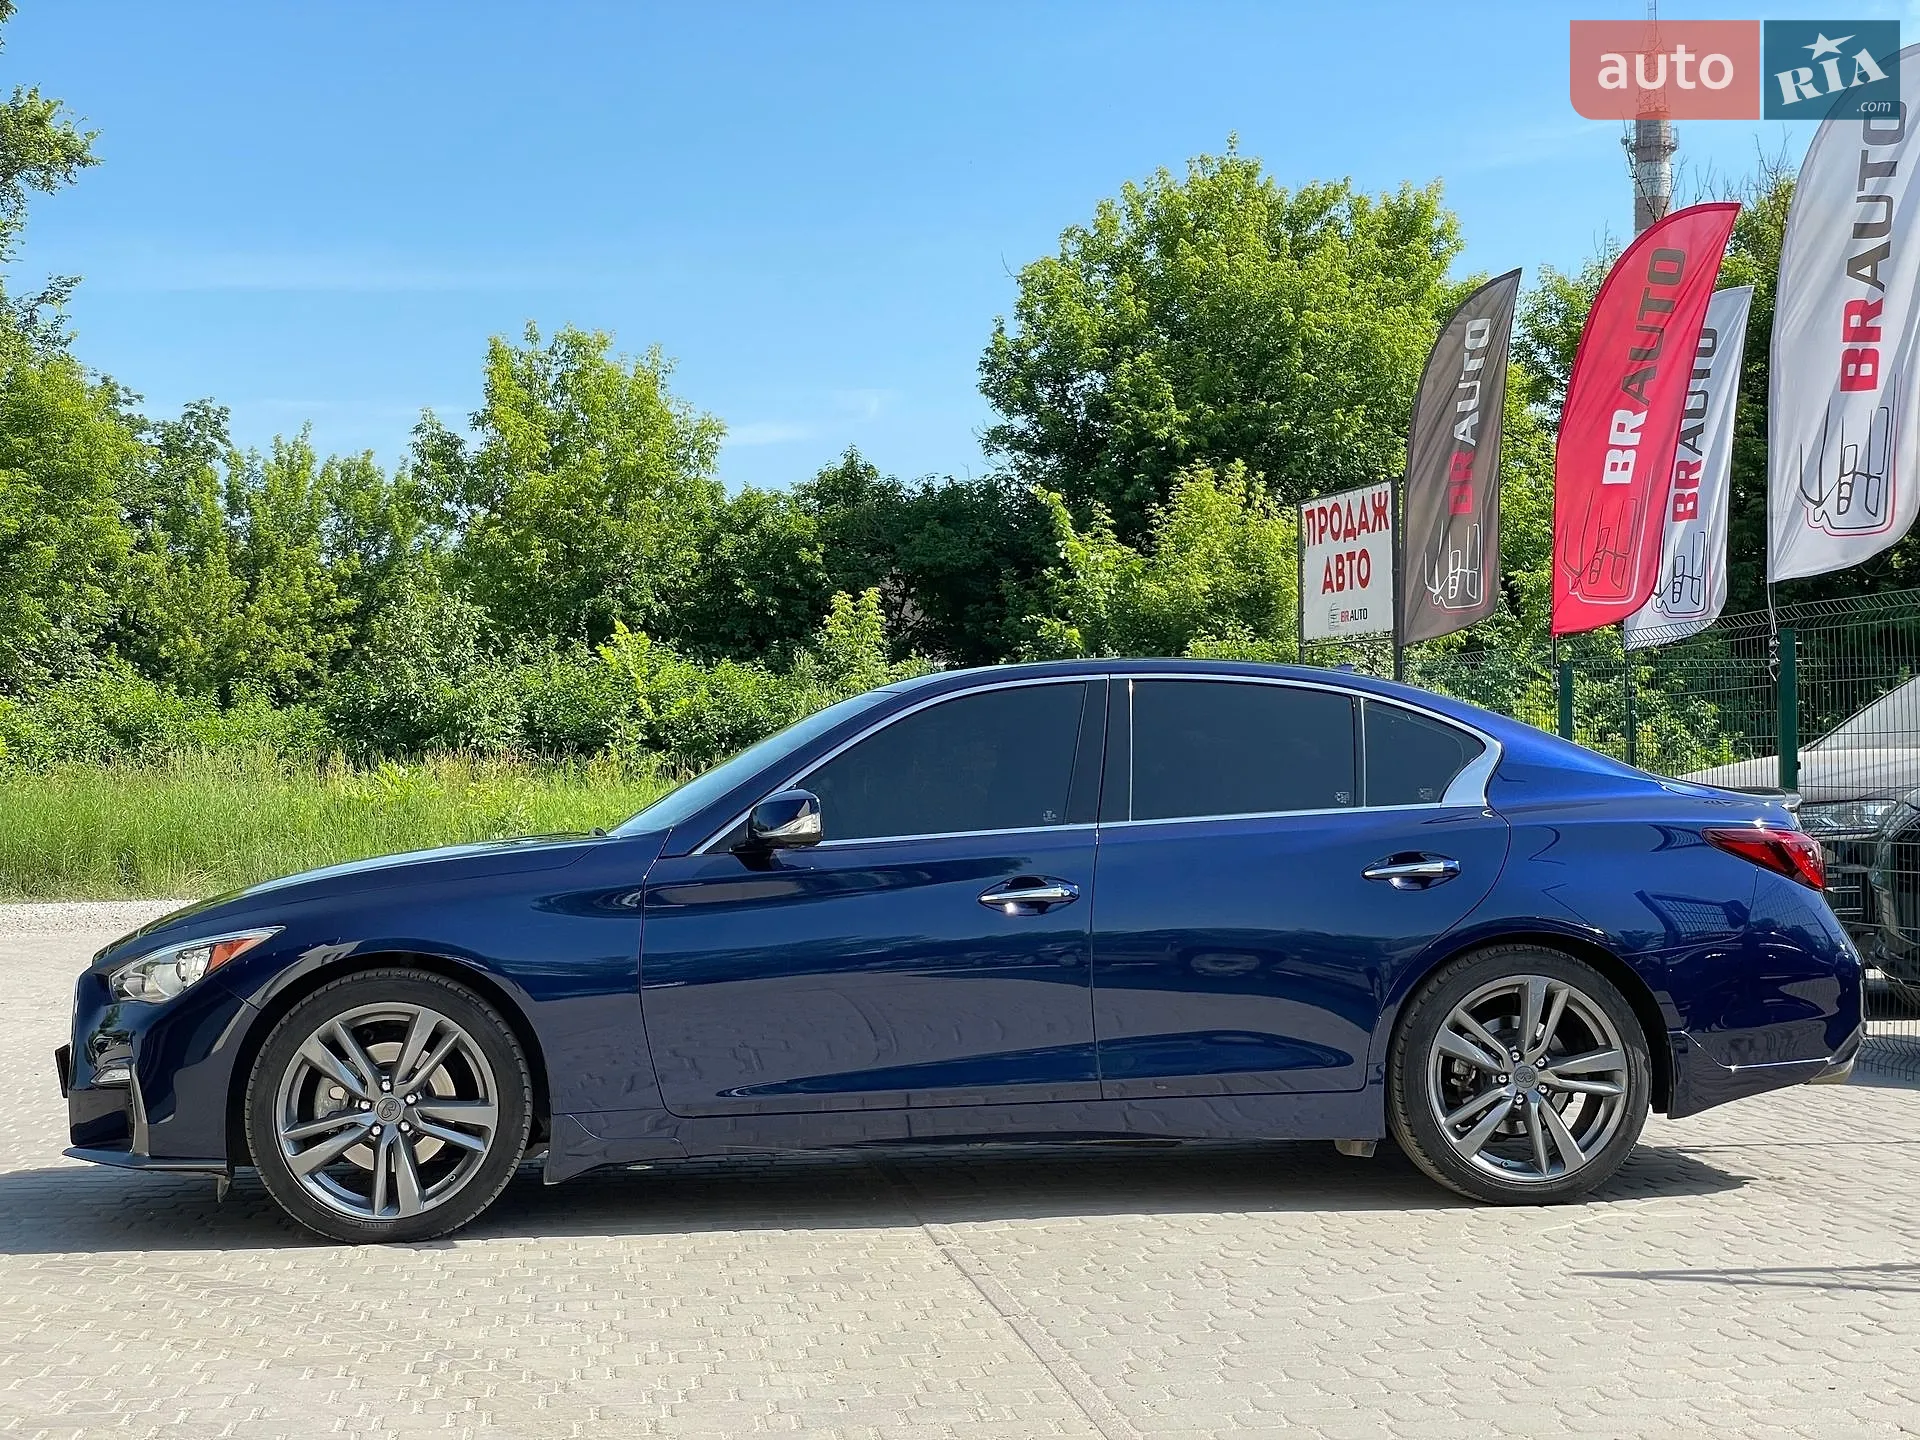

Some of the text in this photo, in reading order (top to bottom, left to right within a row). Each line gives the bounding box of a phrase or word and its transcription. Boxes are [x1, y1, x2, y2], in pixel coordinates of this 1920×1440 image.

[1447, 317, 1491, 515] BRAUTO
[1601, 247, 1687, 485] BRAUTO
[1304, 490, 1390, 547] ПРОДАЖ
[1321, 548, 1372, 595] АВТО
